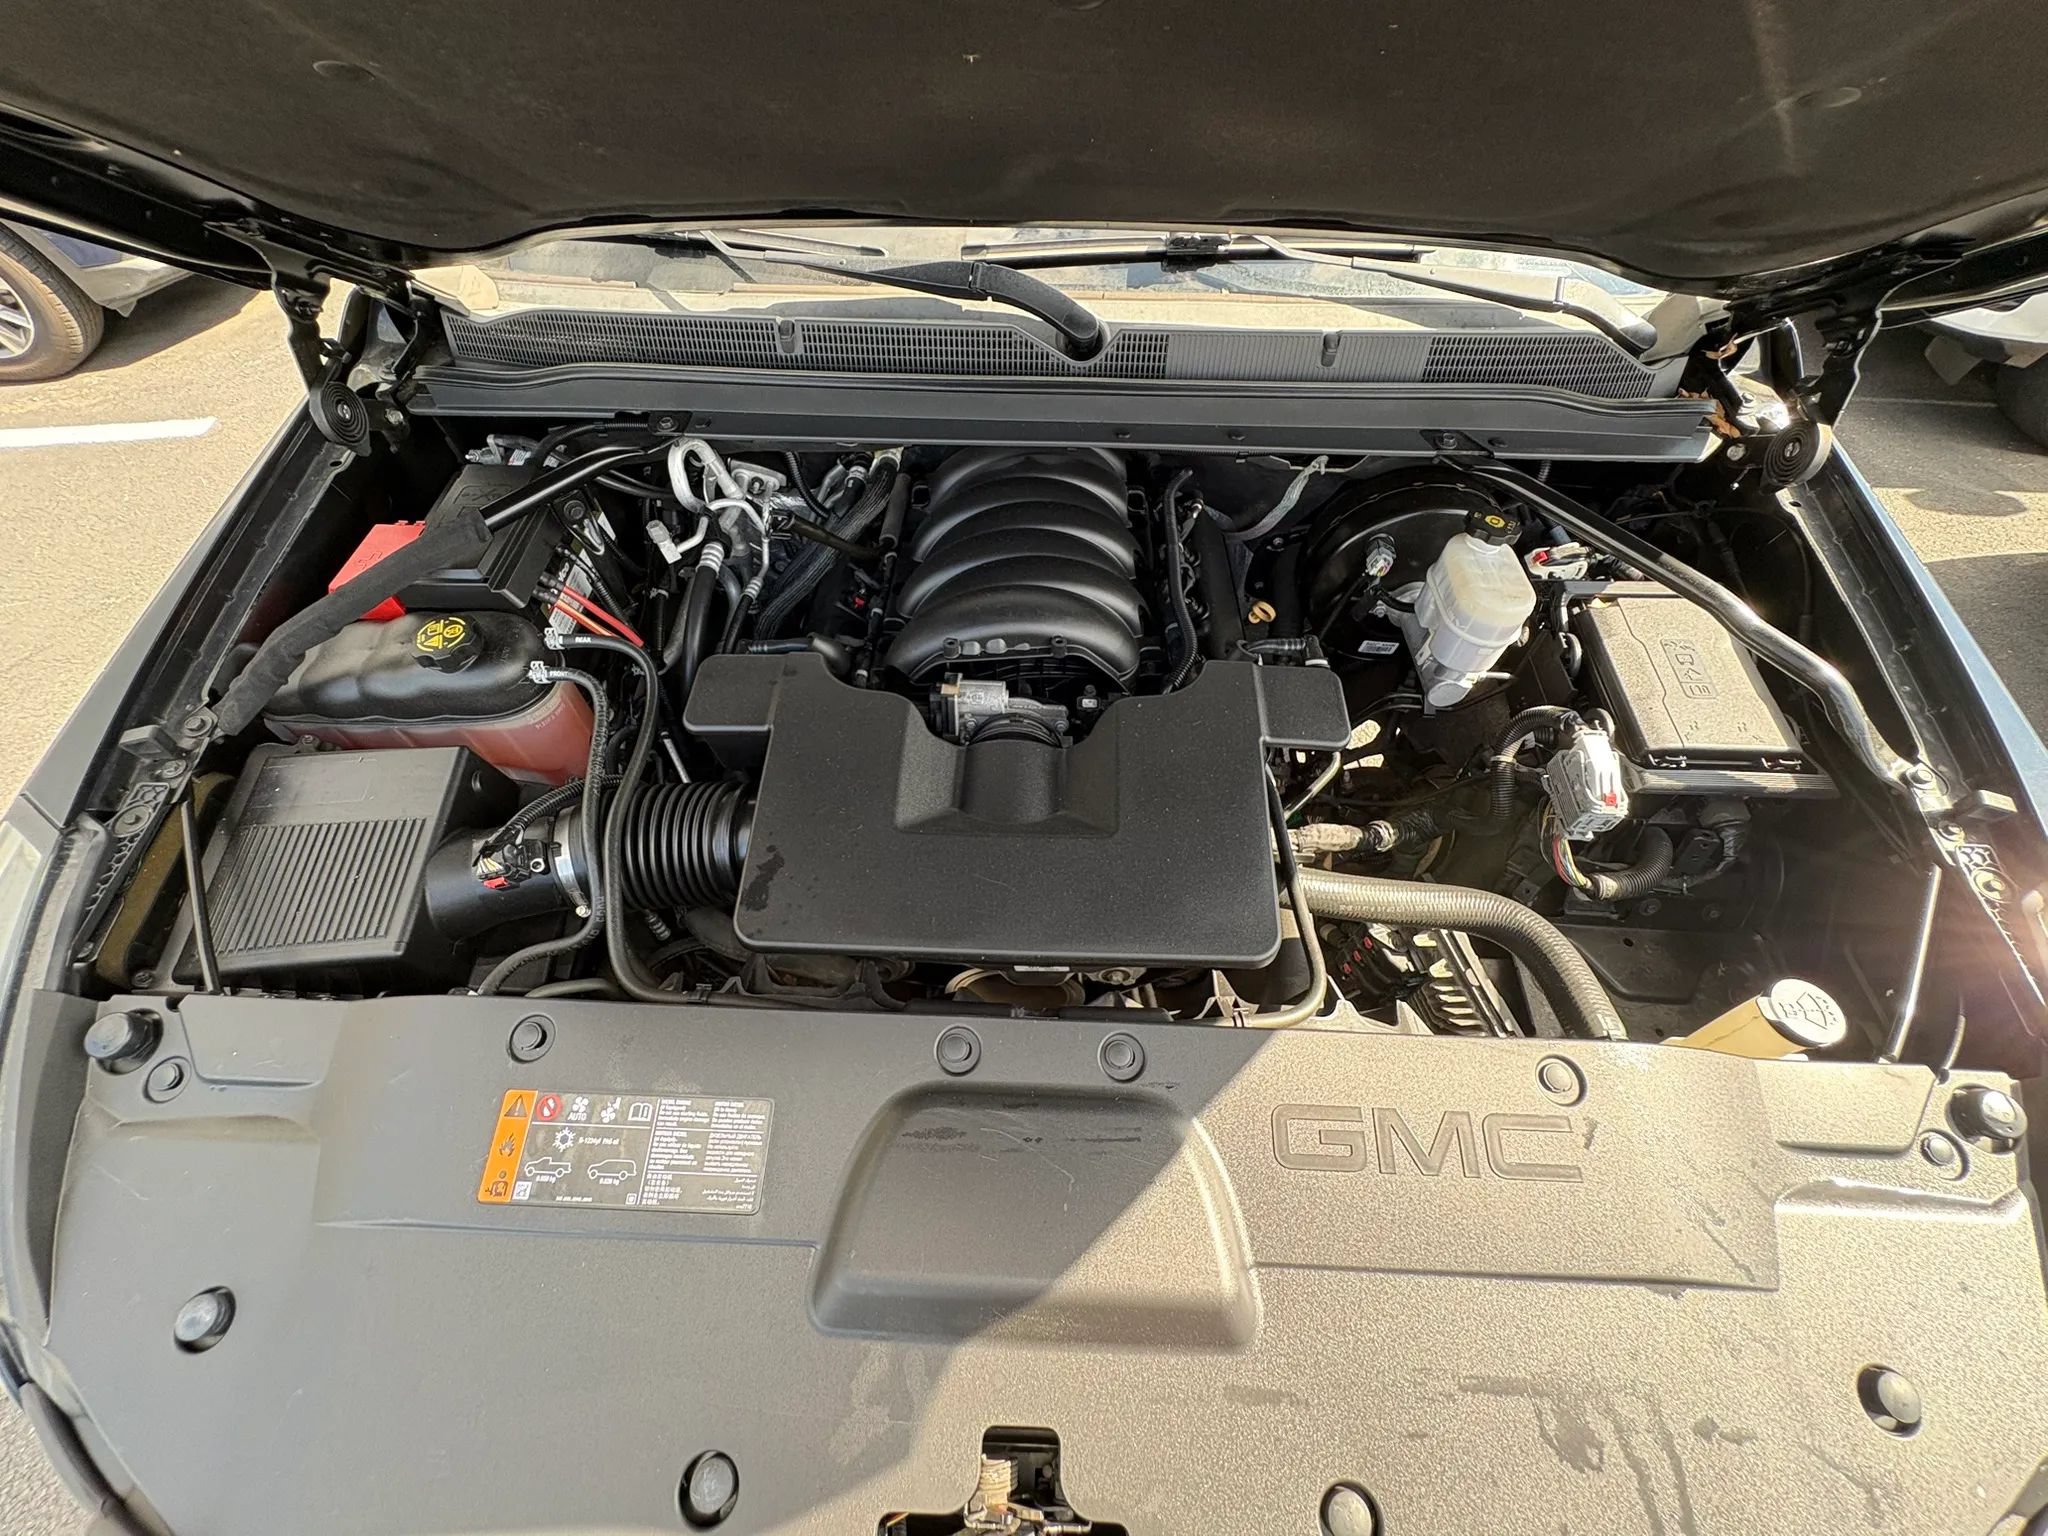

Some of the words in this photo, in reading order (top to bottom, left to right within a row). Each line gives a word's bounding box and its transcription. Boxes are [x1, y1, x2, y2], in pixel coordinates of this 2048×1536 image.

[549, 670, 569, 678] FRONT
[567, 1112, 587, 1121] AUTO
[1271, 1104, 1584, 1183] GMC
